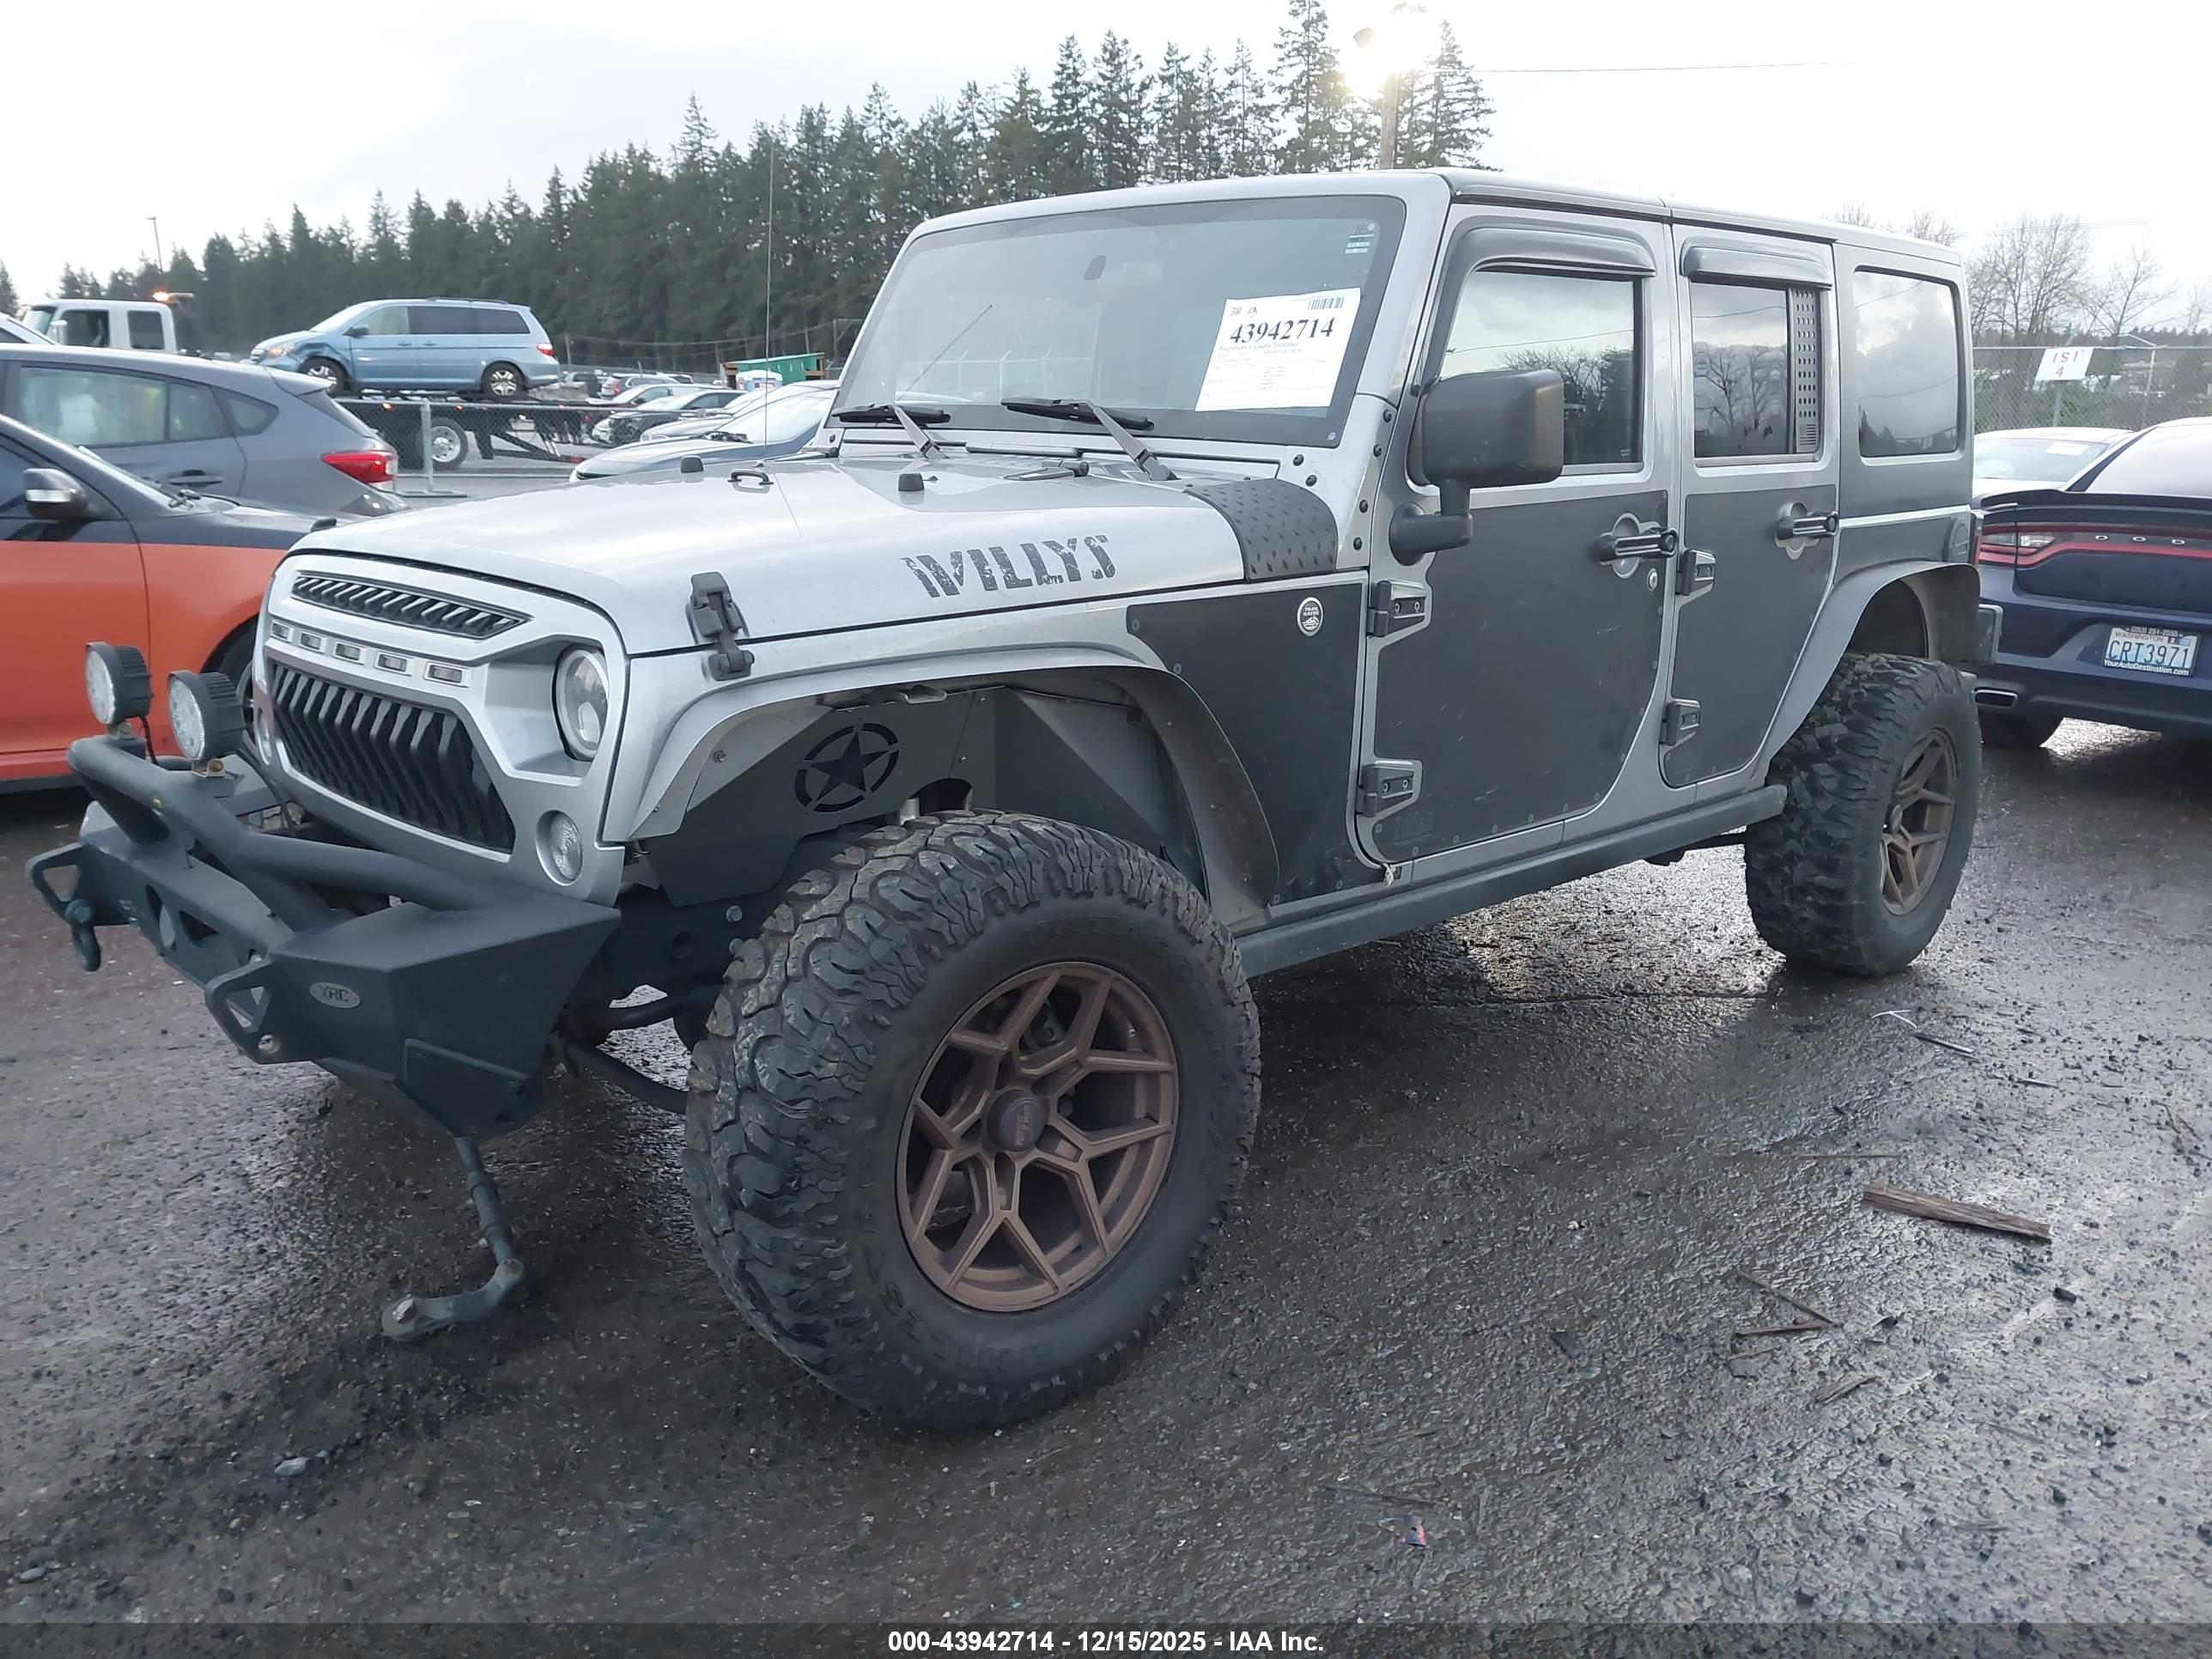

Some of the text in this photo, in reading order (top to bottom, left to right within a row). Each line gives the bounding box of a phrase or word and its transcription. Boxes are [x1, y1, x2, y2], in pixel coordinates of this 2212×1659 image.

[1230, 317, 1335, 343] 43942714
[900, 535, 1115, 598] WILLYS
[2115, 631, 2164, 642] WASHINGTON
[2108, 640, 2189, 668] CRT3971
[2104, 659, 2190, 676] YourAutoDestination.com
